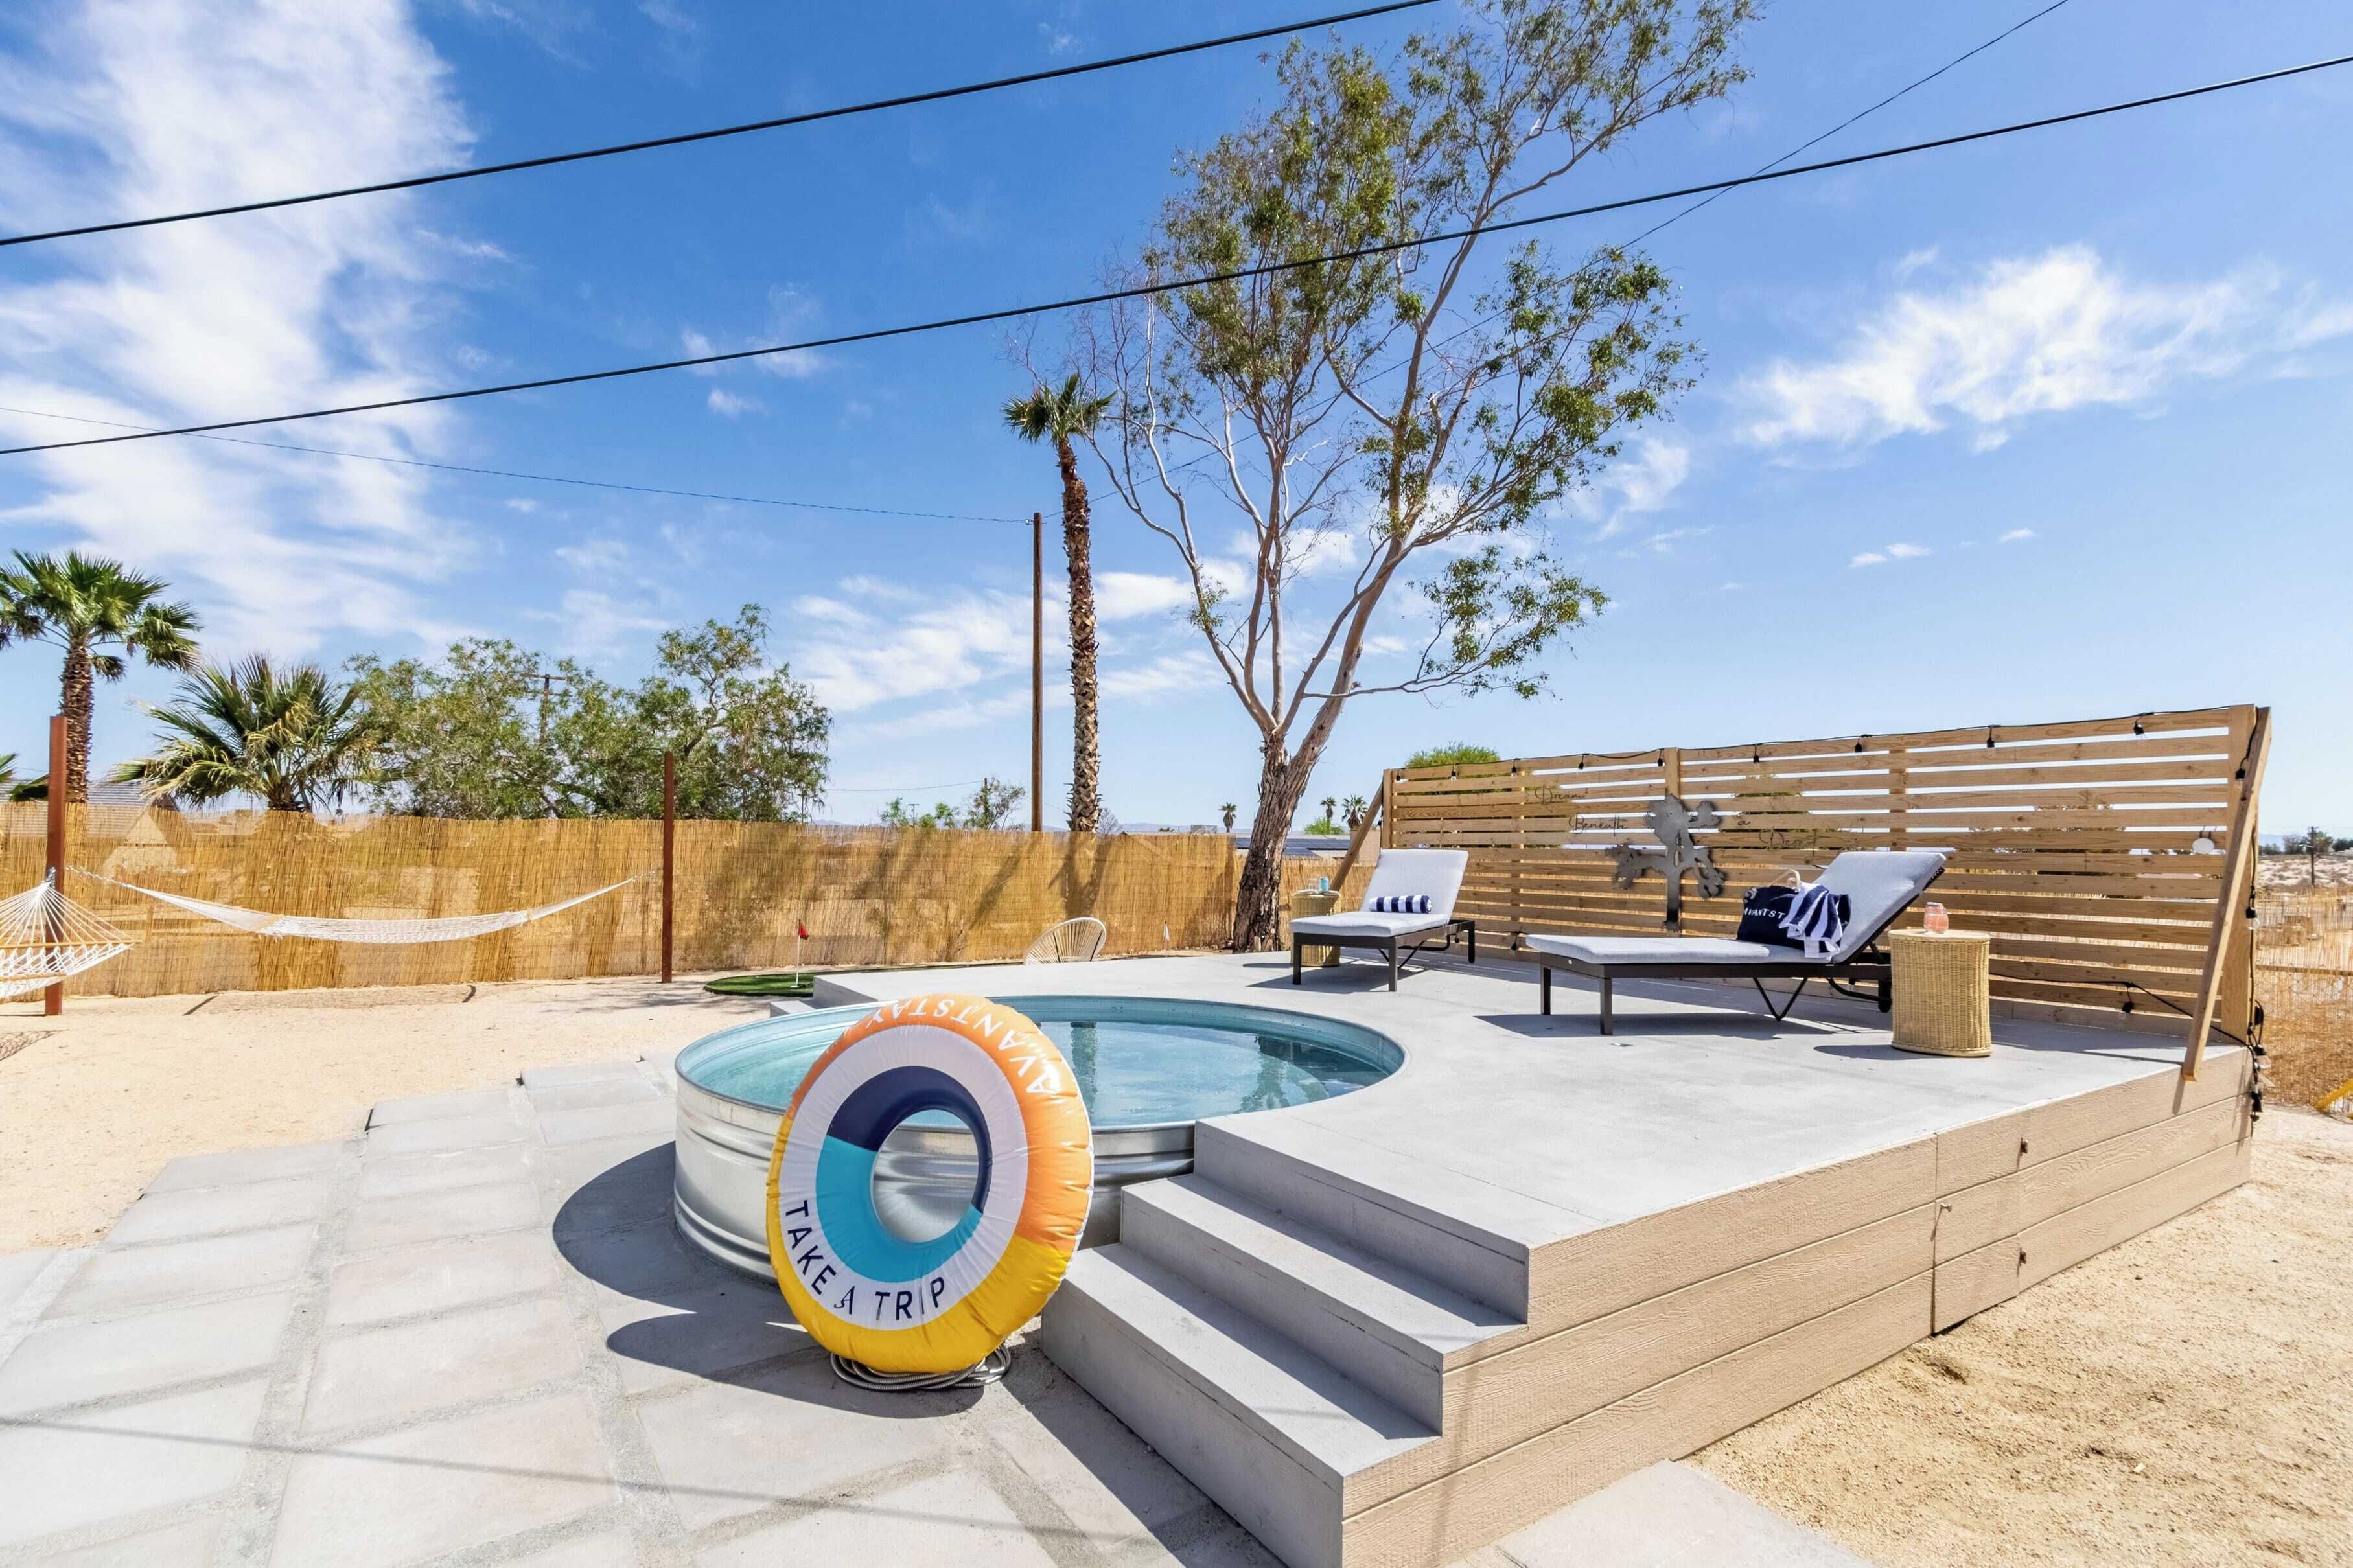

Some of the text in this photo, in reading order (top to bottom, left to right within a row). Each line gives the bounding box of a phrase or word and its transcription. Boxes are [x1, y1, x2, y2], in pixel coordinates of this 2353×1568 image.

[1569, 814, 1628, 836] Beneath
[866, 998, 1063, 1094] AVANTSTAY
[785, 1199, 945, 1320] TAKE A TRIP
